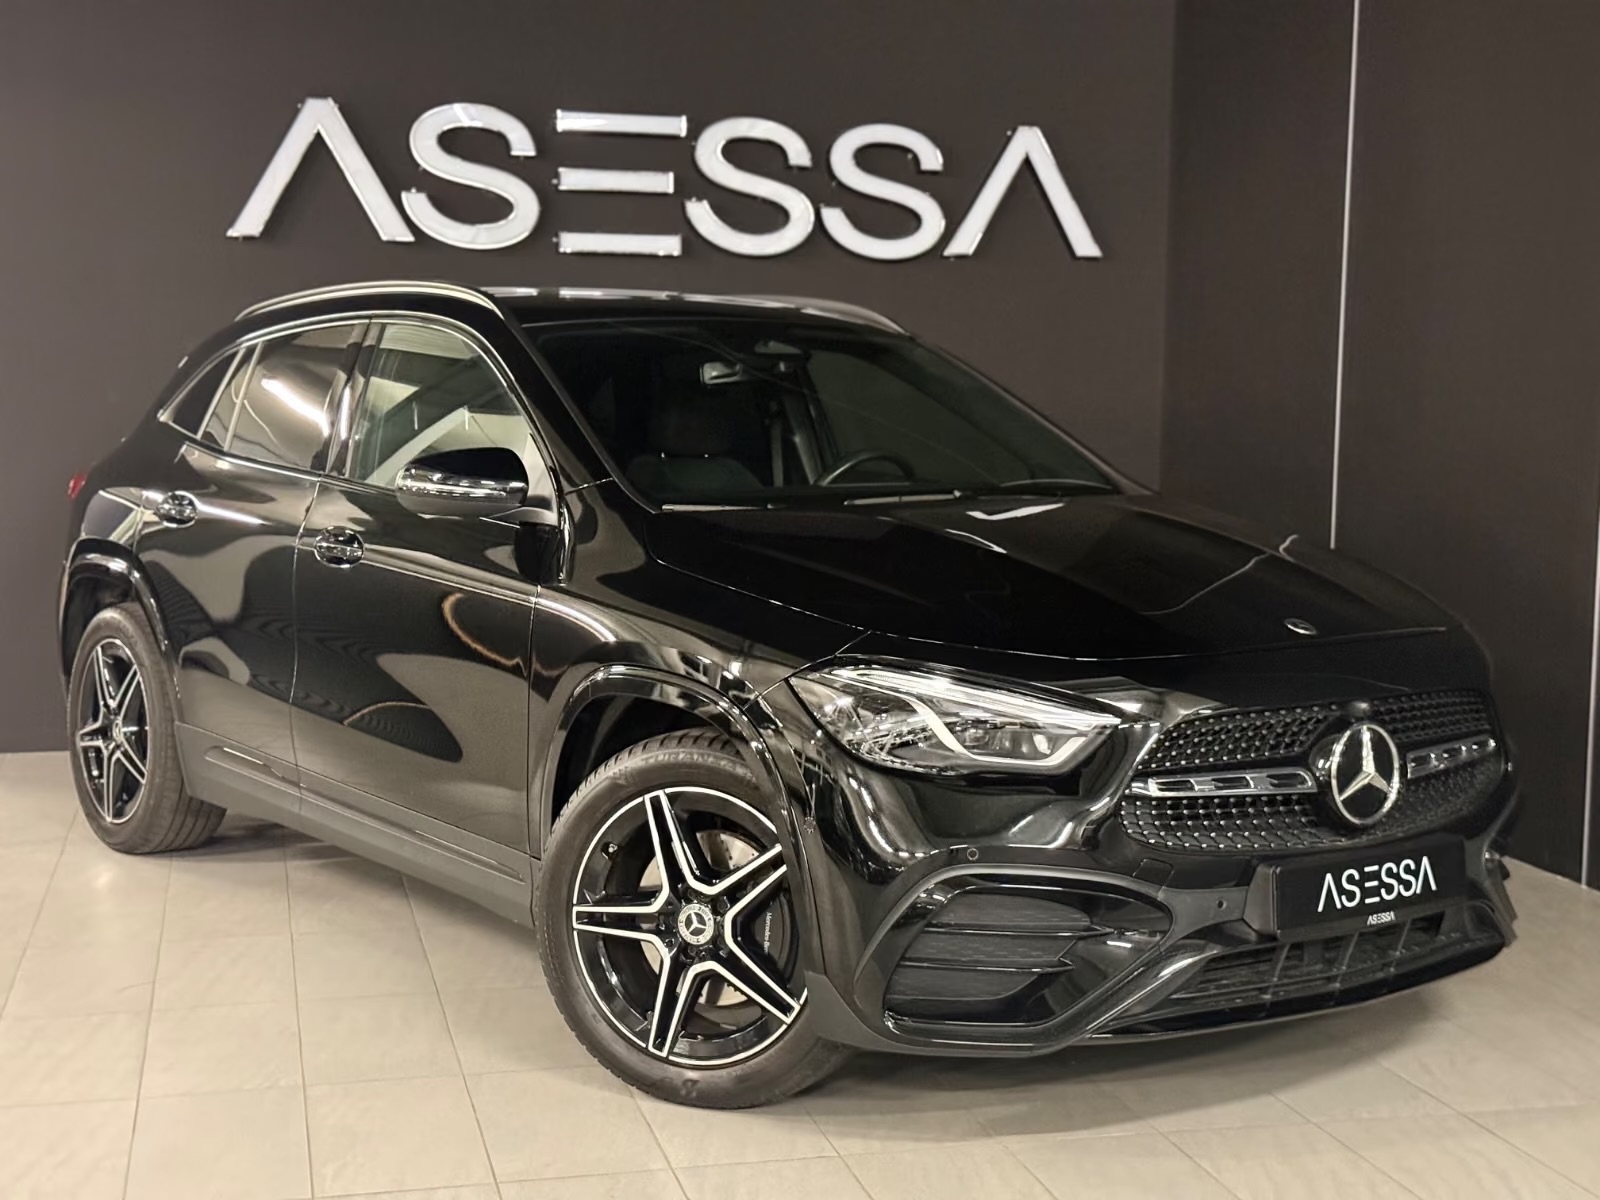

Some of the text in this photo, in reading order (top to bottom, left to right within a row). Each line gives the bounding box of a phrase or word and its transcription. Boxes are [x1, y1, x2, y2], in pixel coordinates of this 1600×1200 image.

[226, 97, 1103, 260] ASESSA
[1317, 856, 1437, 912] ASESSA
[1366, 910, 1396, 926] ASESSA
